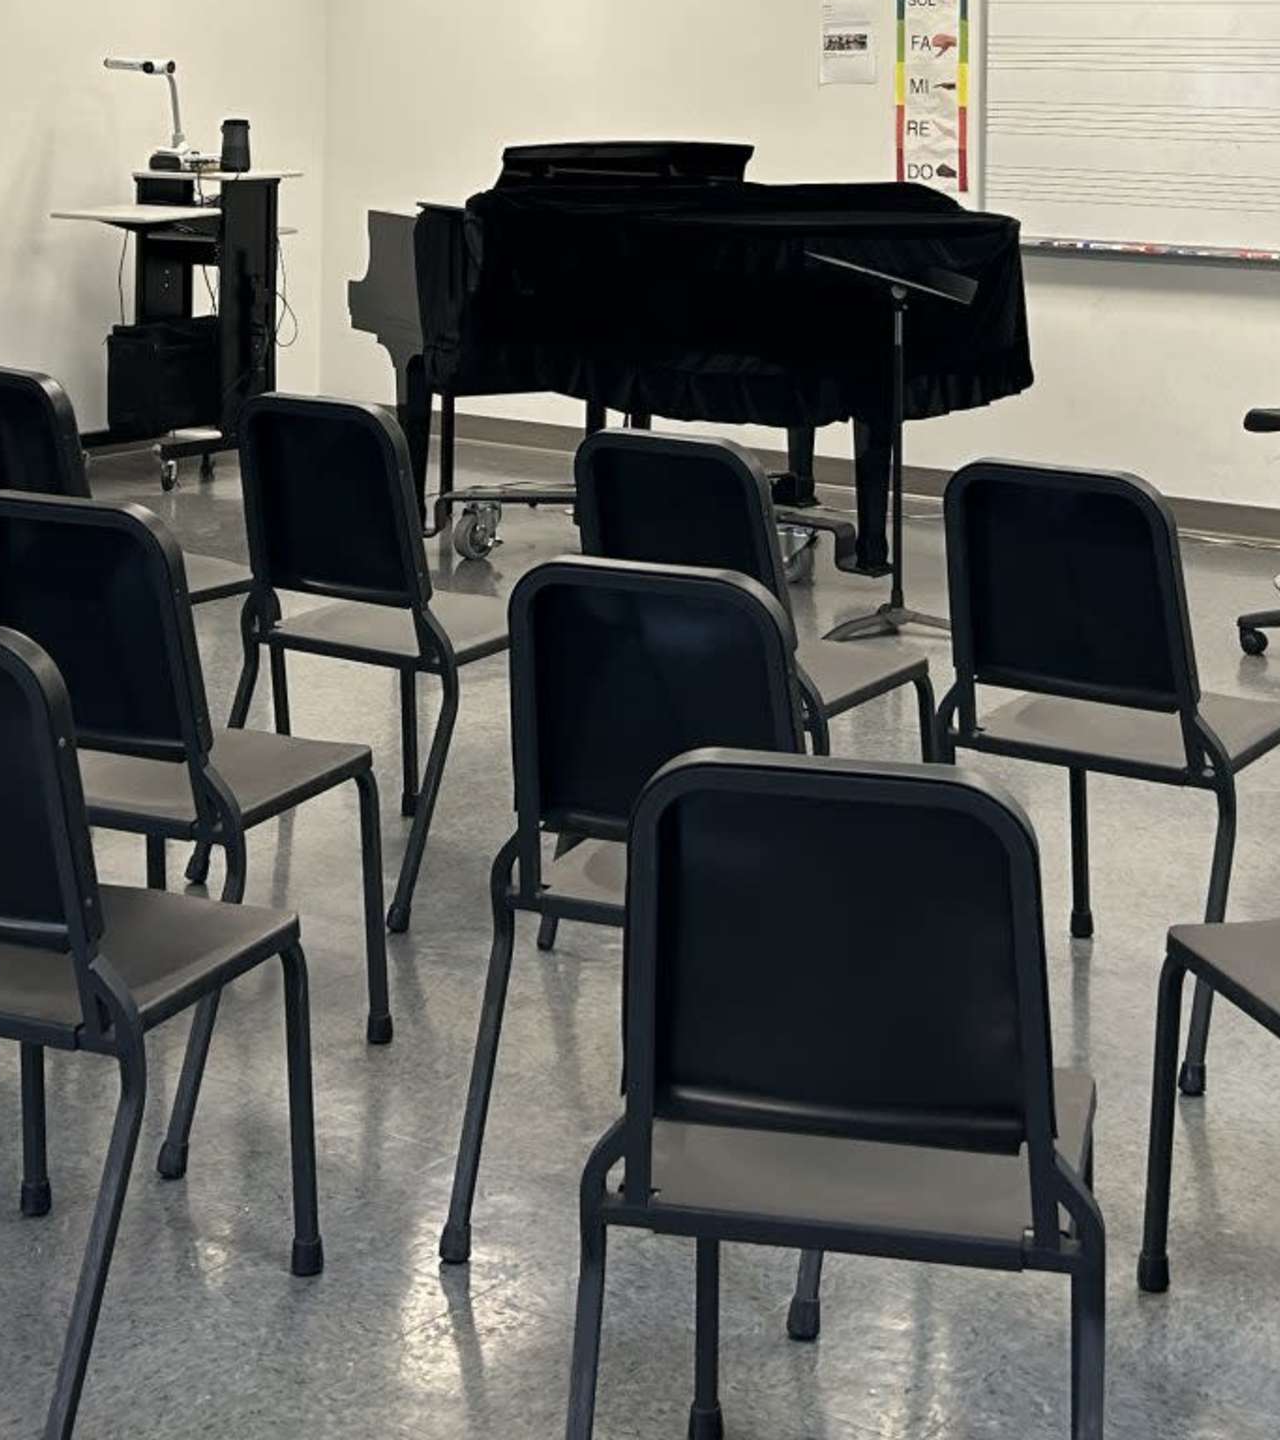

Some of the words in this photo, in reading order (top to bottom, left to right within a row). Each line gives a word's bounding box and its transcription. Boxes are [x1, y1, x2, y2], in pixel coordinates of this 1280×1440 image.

[911, 35, 932, 51] FA
[909, 78, 930, 95] MI
[907, 120, 931, 137] RE
[907, 164, 934, 180] DO
